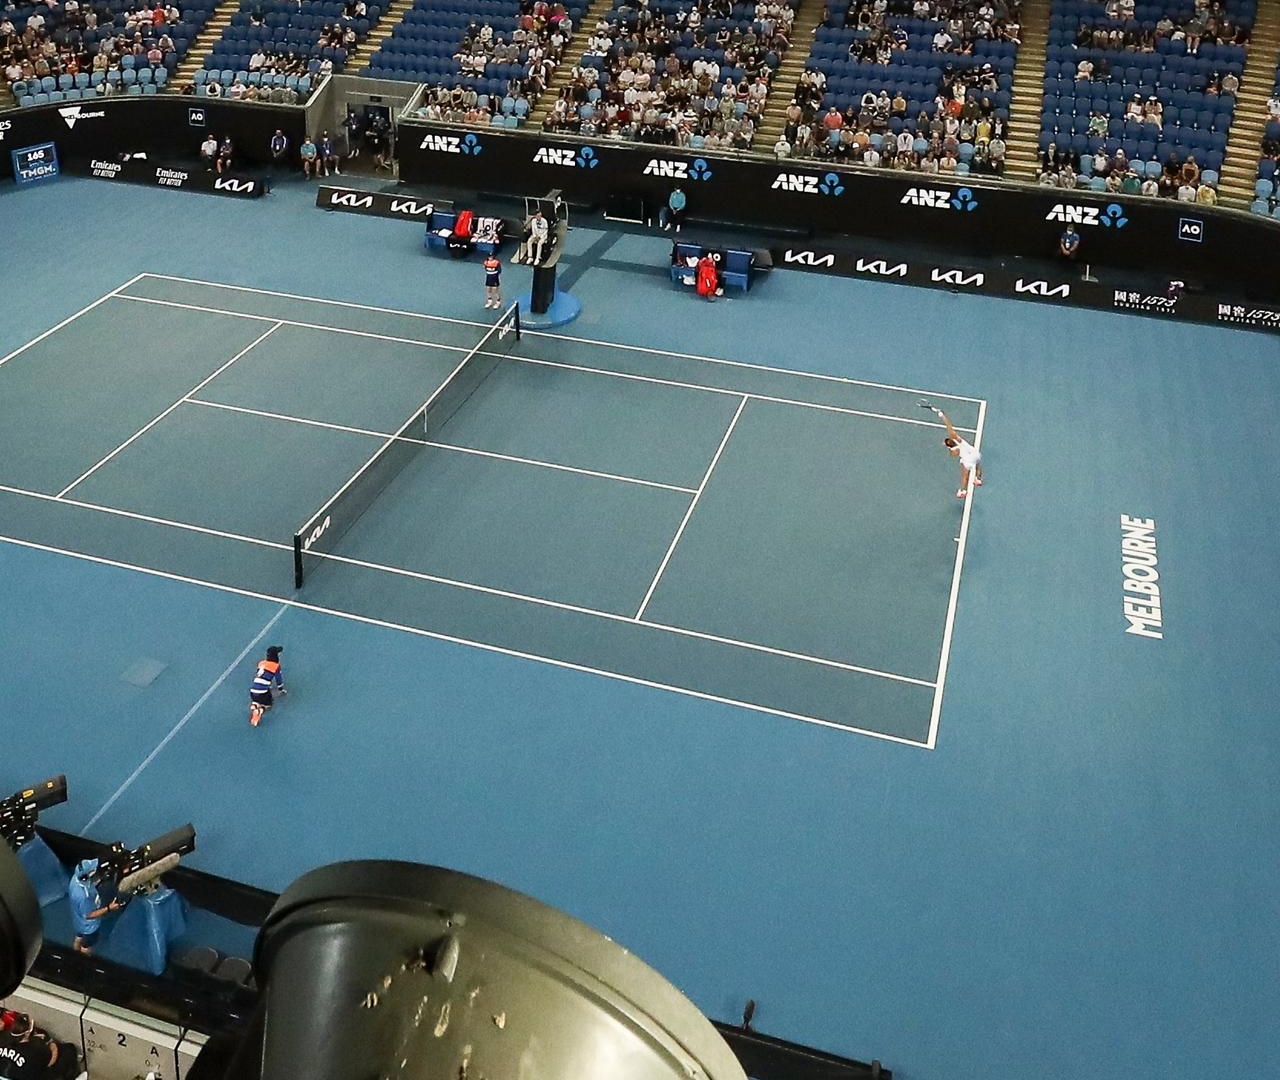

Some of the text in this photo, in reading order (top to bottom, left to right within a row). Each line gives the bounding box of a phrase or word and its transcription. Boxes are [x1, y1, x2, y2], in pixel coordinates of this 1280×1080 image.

[191, 113, 204, 121] AO
[420, 133, 462, 154] ANZ
[27, 150, 45, 162] 165
[90, 159, 122, 172] Emirates
[532, 146, 577, 168] ANZ
[155, 167, 189, 181] Emirates
[643, 158, 689, 180] ANZ
[214, 177, 255, 193] KIA
[771, 172, 819, 195] ANZ
[331, 192, 373, 208] KIA
[900, 187, 952, 210] ANZ
[1045, 202, 1100, 227] ANZ
[1181, 223, 1202, 236] AO
[784, 248, 835, 269] KIA
[856, 256, 908, 278] KIA
[931, 266, 985, 288] KIA
[1015, 277, 1071, 300] KIA
[1120, 513, 1163, 640] MELBOURNE
[116, 1032, 128, 1048] 2
[149, 1045, 160, 1058] A
